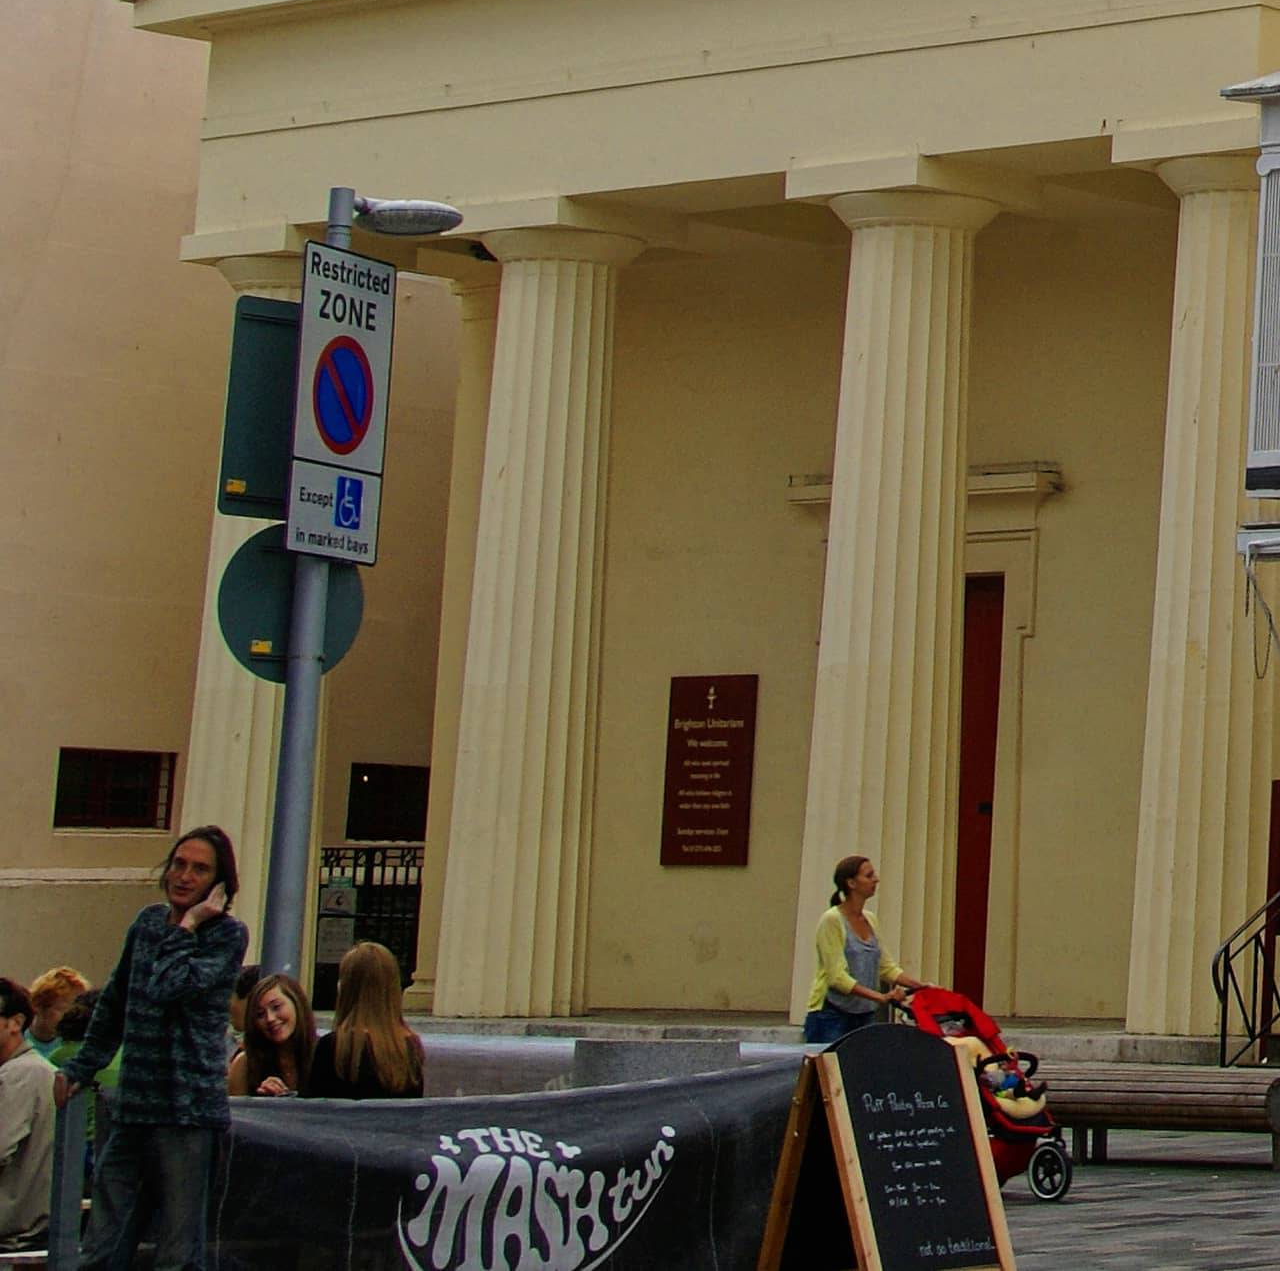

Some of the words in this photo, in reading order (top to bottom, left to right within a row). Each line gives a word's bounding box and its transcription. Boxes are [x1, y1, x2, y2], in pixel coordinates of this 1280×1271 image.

[311, 252, 391, 295] Restricted
[320, 289, 377, 332] ZONE
[299, 486, 333, 509] Except
[295, 528, 306, 543] in
[307, 532, 345, 550] marked
[347, 535, 369, 555] bays
[457, 1127, 549, 1159] THE
[408, 1154, 608, 1271] MASH
